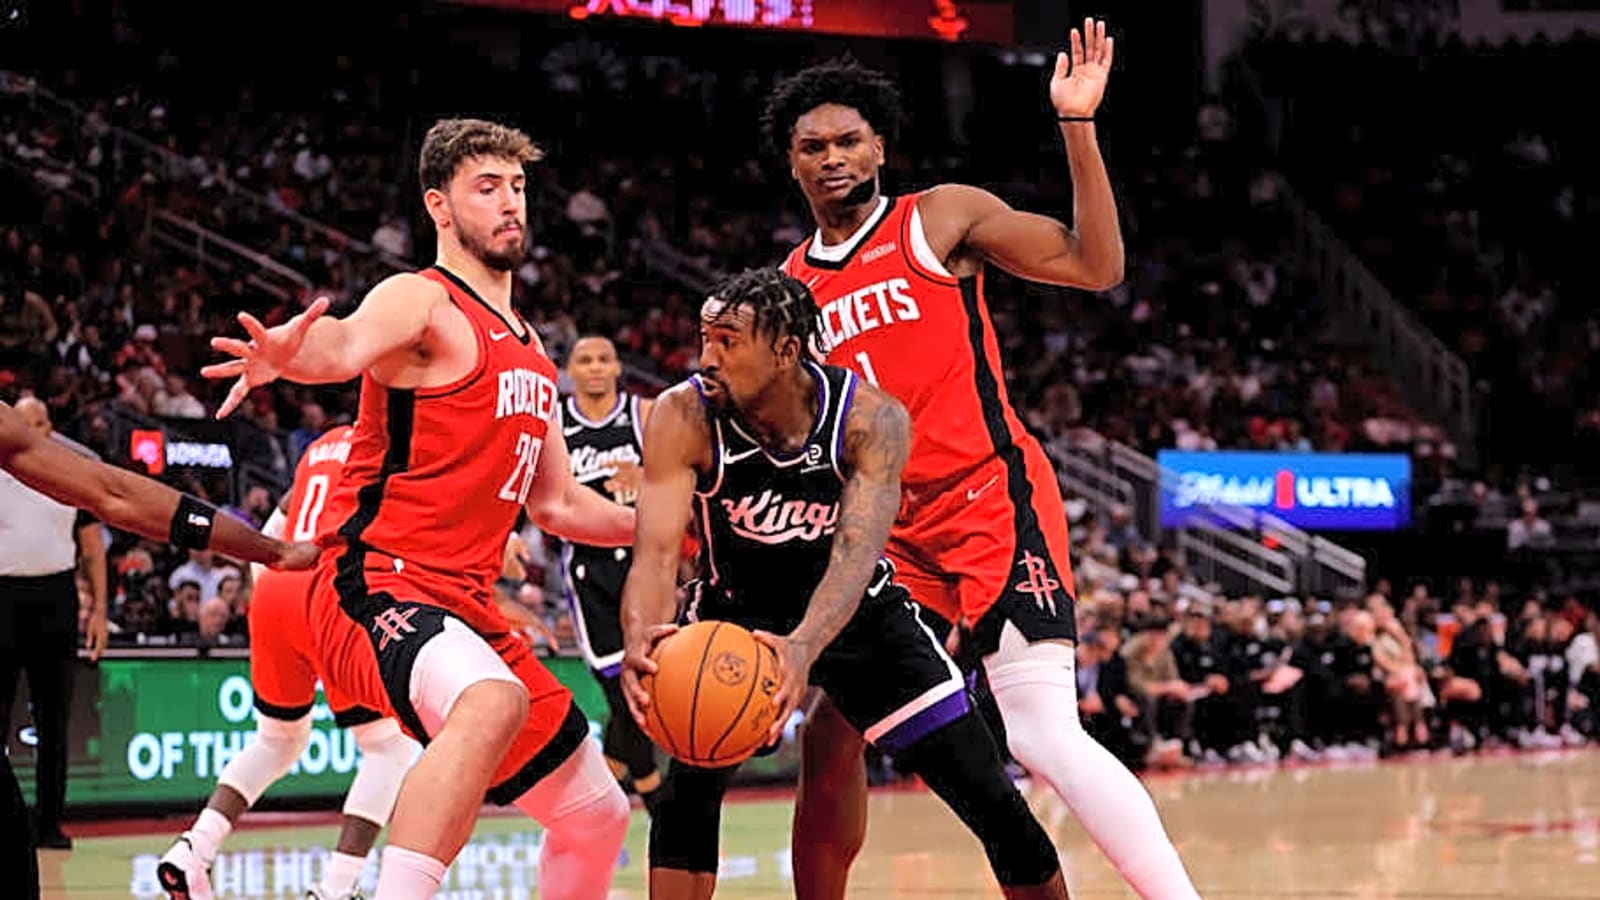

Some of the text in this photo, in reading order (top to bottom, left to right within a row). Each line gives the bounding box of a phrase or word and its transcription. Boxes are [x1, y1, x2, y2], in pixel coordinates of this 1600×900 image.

[855, 351, 880, 389] 1
[498, 431, 543, 505] 28
[1297, 476, 1395, 508] ULTRA
[293, 474, 329, 541] 0
[127, 732, 183, 780] OF
